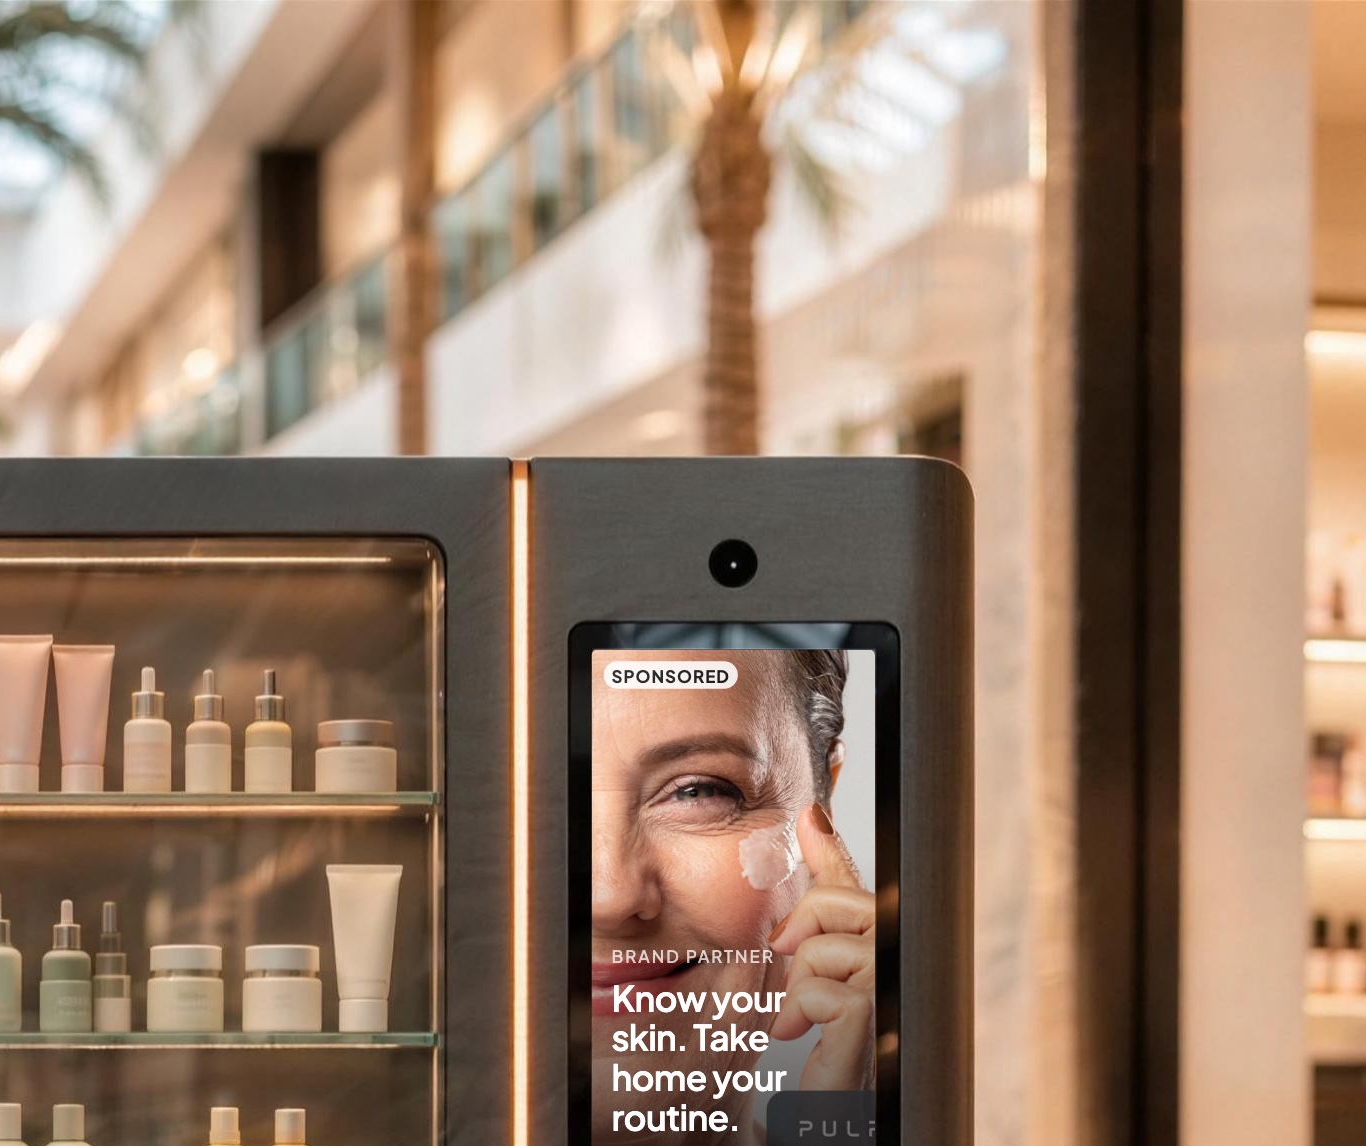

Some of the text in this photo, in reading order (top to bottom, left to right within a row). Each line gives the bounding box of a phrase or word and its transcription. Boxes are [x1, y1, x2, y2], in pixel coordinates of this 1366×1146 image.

[612, 669, 730, 685] SPONSORED
[612, 949, 774, 964] BRAND PARTNER
[613, 984, 787, 1021] Know your
[612, 1023, 769, 1052] skin. Take
[613, 1063, 787, 1100] home your
[613, 1103, 738, 1132] routine.
